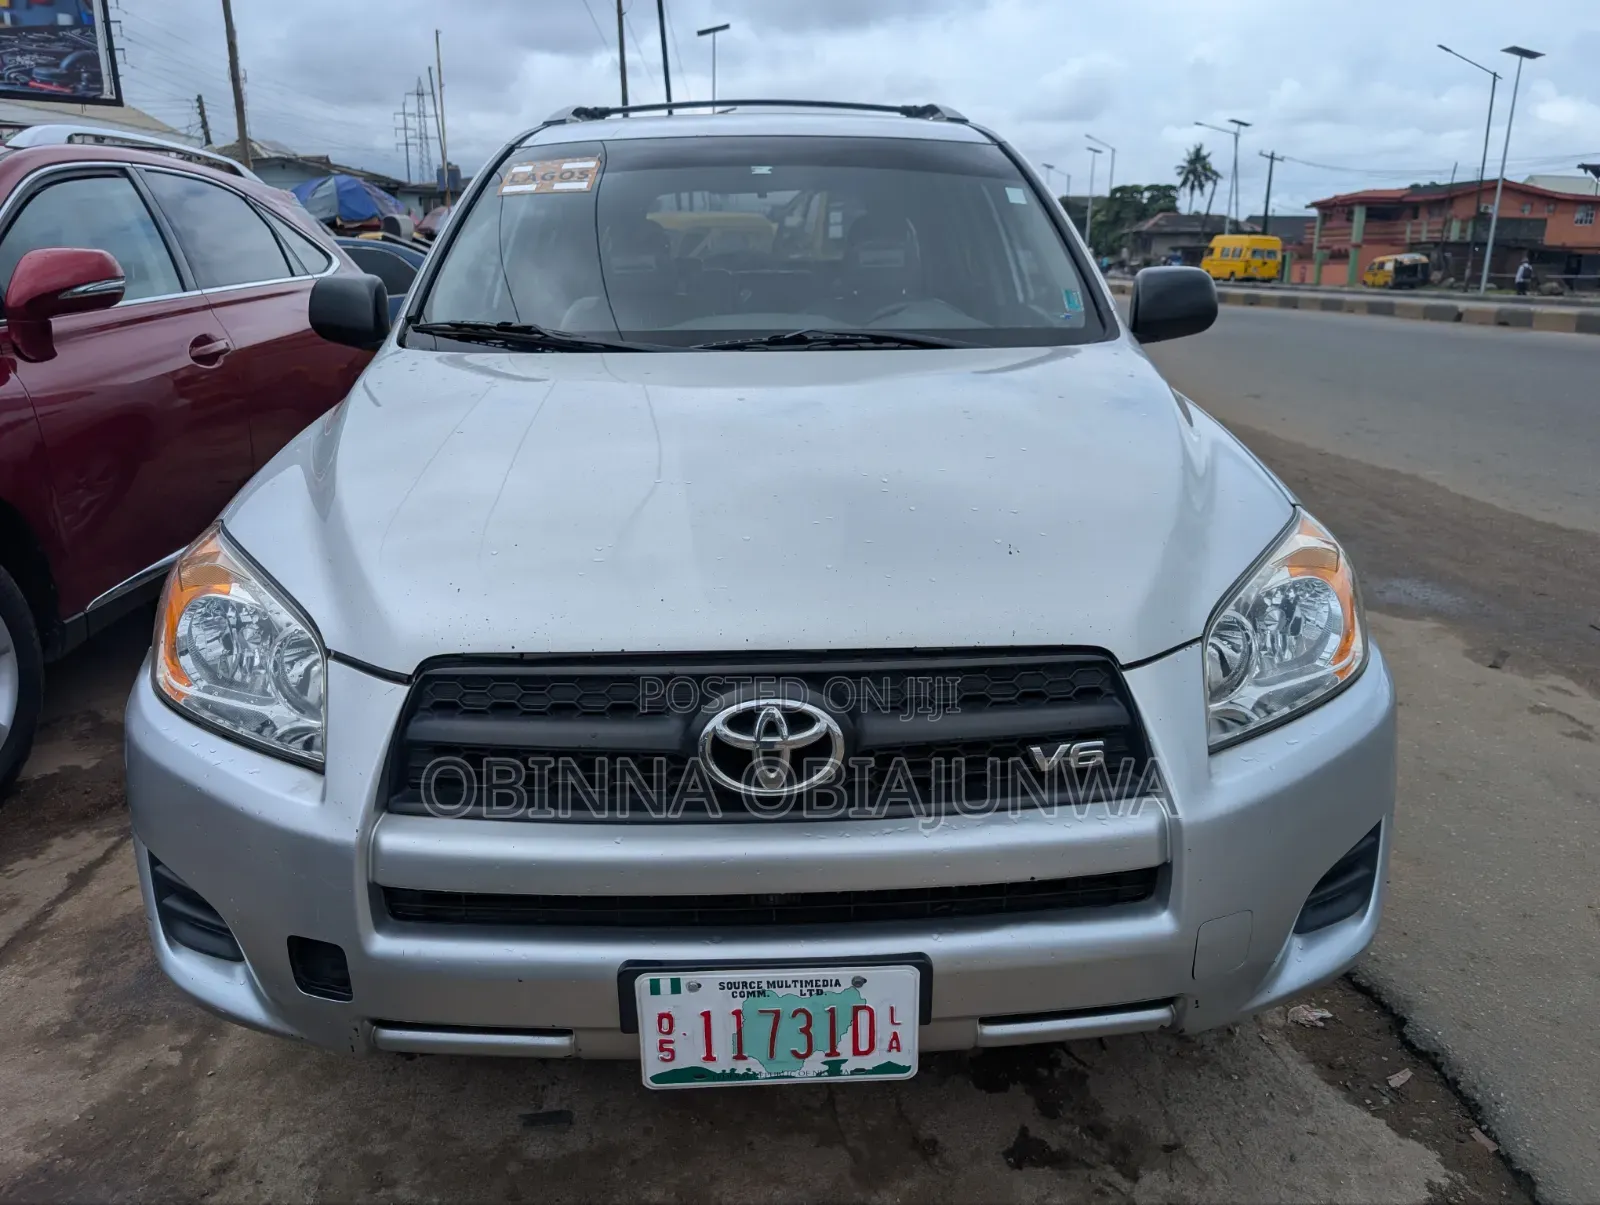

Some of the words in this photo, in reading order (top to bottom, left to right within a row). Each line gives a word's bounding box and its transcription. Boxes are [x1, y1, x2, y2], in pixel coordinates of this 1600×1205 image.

[1029, 740, 1105, 772] V6
[718, 980, 763, 991] SOURCE
[766, 978, 842, 989] MULTIMEDIA
[731, 990, 770, 999] COMM.
[799, 988, 828, 998] LTD.
